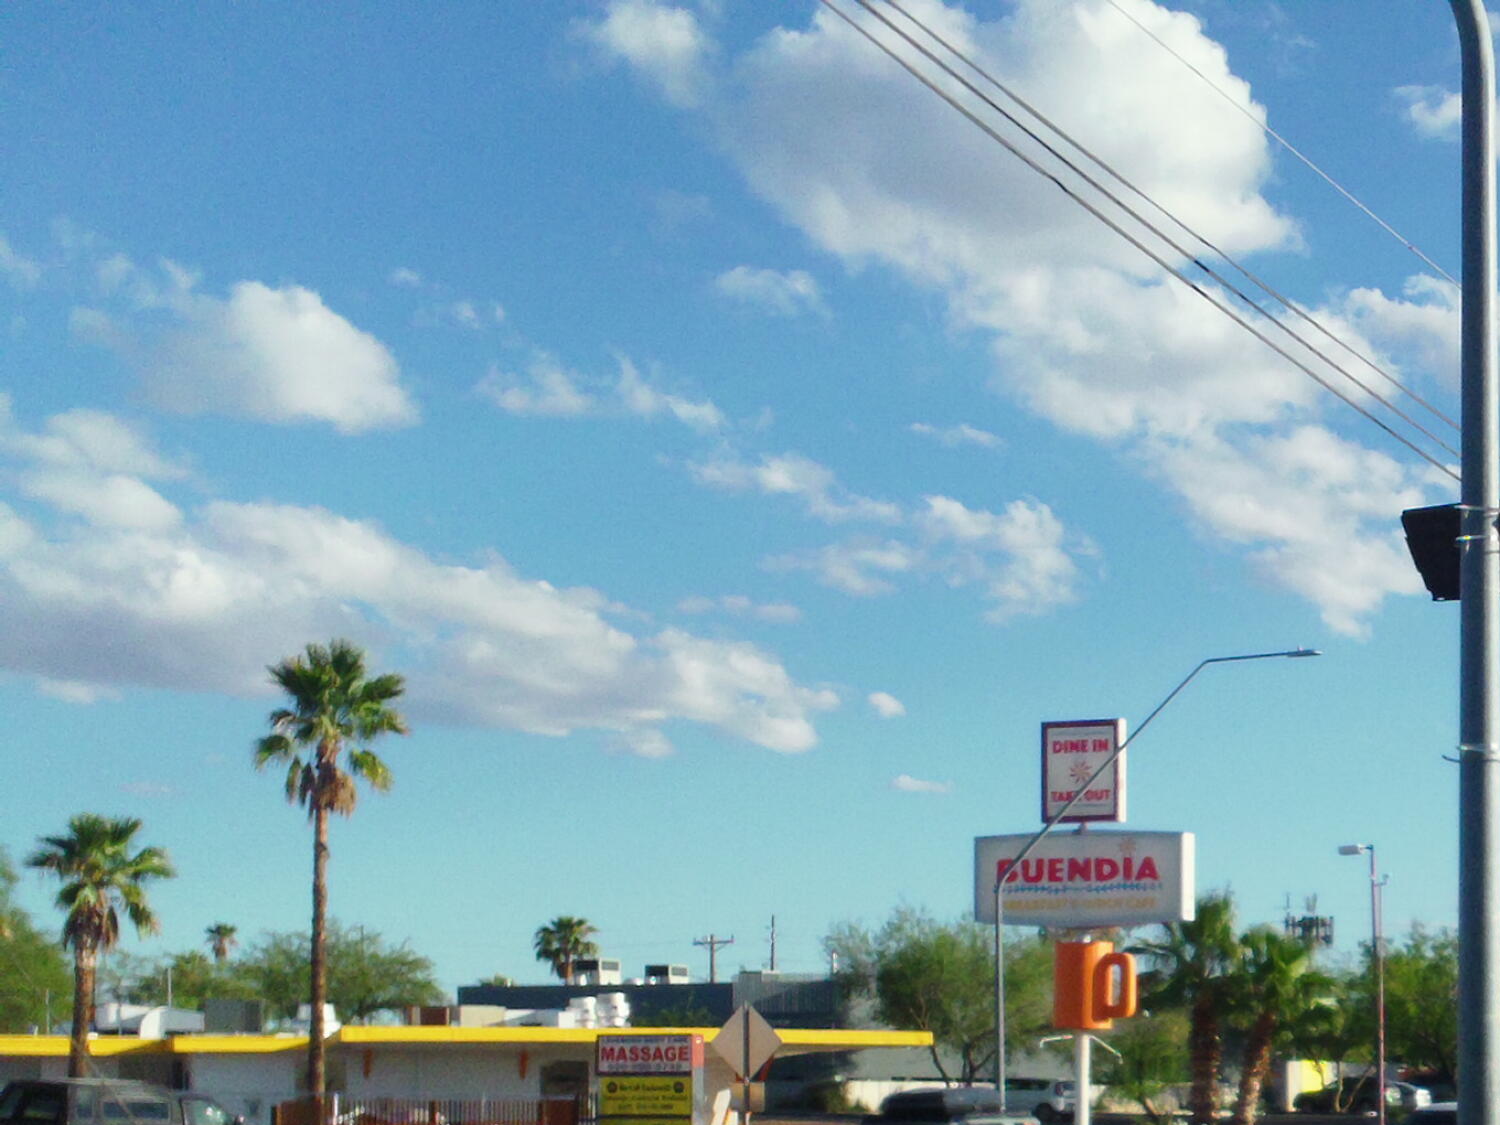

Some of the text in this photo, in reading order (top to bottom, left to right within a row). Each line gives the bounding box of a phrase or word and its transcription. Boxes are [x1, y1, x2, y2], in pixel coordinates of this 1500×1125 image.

[1052, 738, 1109, 754] DINE IN
[1084, 789, 1111, 802] OUT
[601, 1046, 689, 1062] MASSAGE
